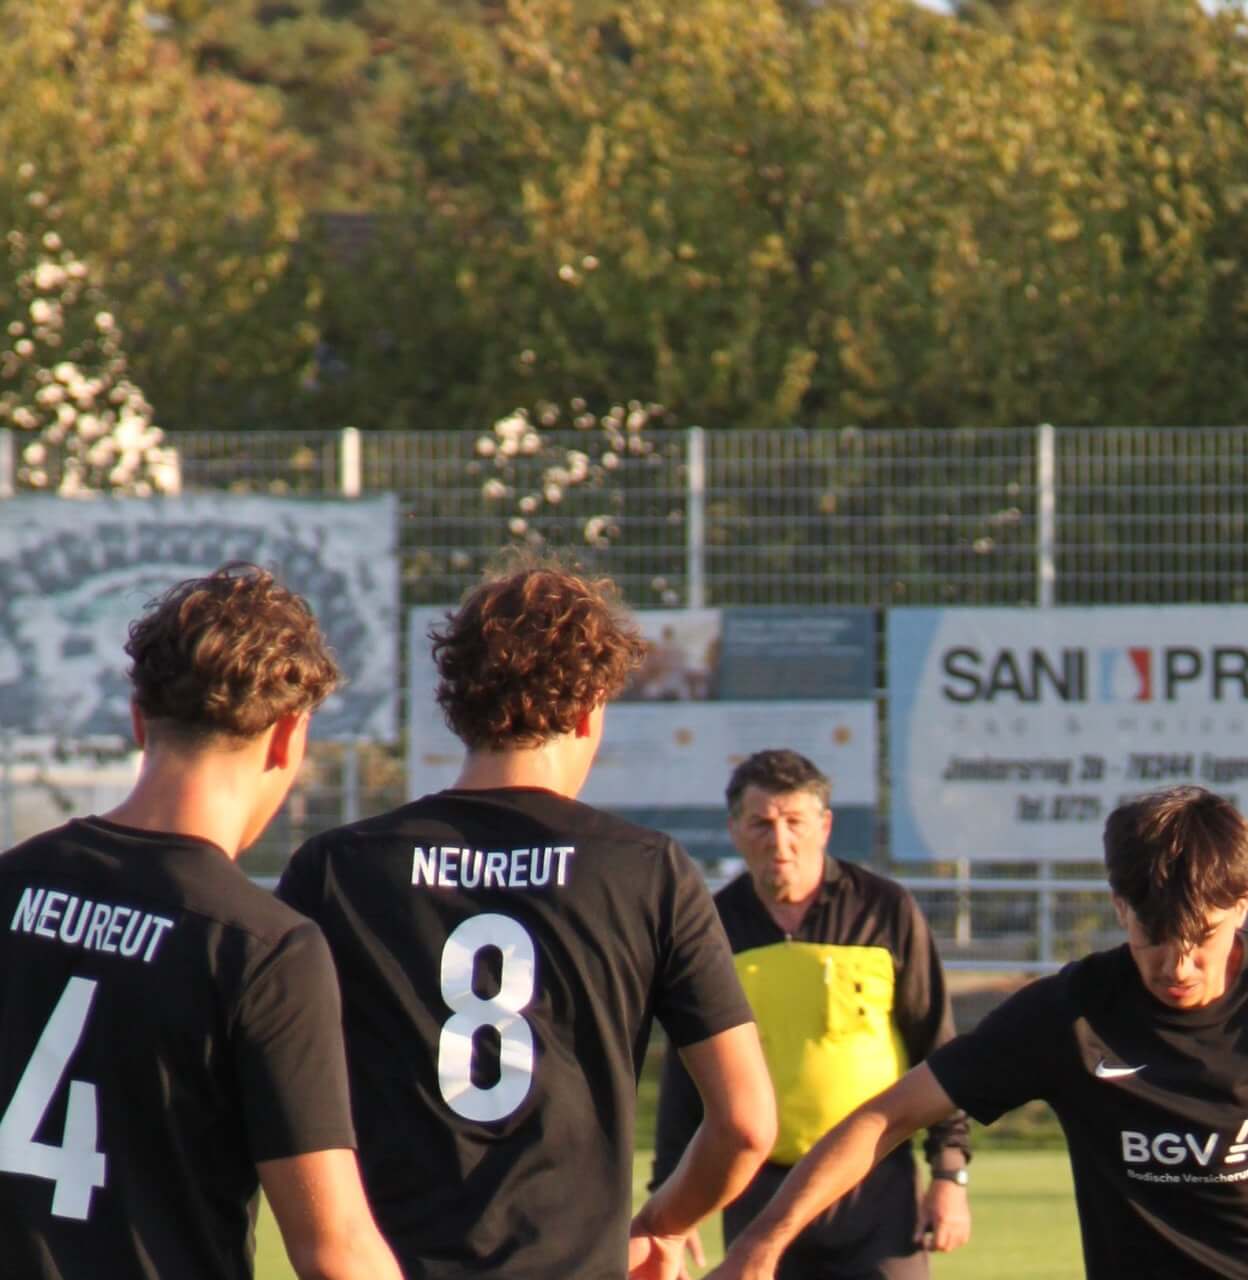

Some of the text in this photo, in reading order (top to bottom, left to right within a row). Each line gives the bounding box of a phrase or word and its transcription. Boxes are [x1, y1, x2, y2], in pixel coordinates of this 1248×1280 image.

[942, 647, 1087, 704] SANI
[411, 846, 576, 888] NEUREUT
[10, 887, 174, 963] NEUREUT
[437, 913, 536, 1122] 8
[0, 976, 106, 1221] 4
[1120, 1130, 1219, 1166] BGV
[1127, 1168, 1180, 1183] Badische
